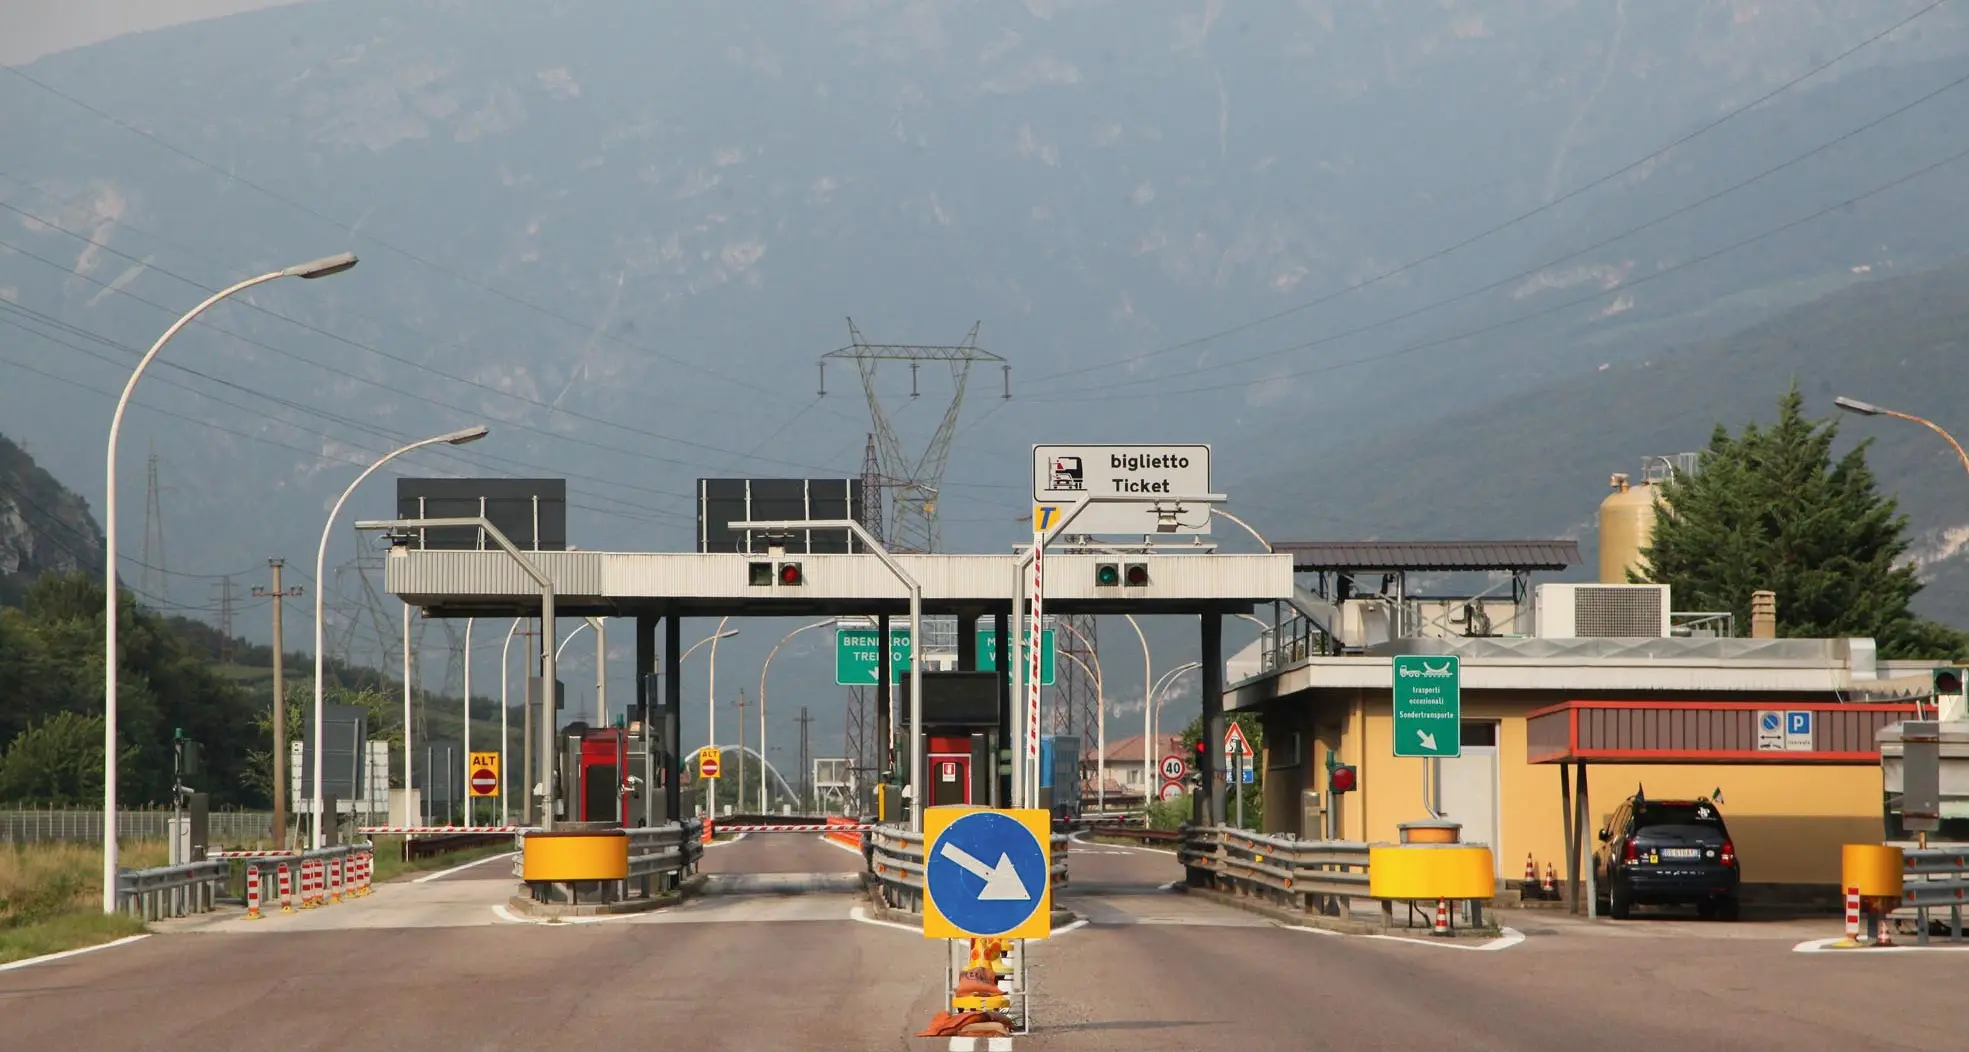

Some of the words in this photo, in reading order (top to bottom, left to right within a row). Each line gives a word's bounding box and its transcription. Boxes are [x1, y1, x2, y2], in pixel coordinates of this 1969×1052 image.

[1111, 454, 1189, 471] biglietto
[1112, 479, 1170, 493] Ticket
[1040, 507, 1056, 529] T
[843, 636, 910, 647] BRENRO
[853, 651, 902, 661] TREO
[1412, 686, 1440, 694] trasporti
[1409, 697, 1444, 705] eccezionali
[1400, 711, 1454, 719] Sondertransporte
[1793, 715, 1804, 731] P
[473, 756, 496, 766] ALT
[1166, 762, 1180, 774] 40
